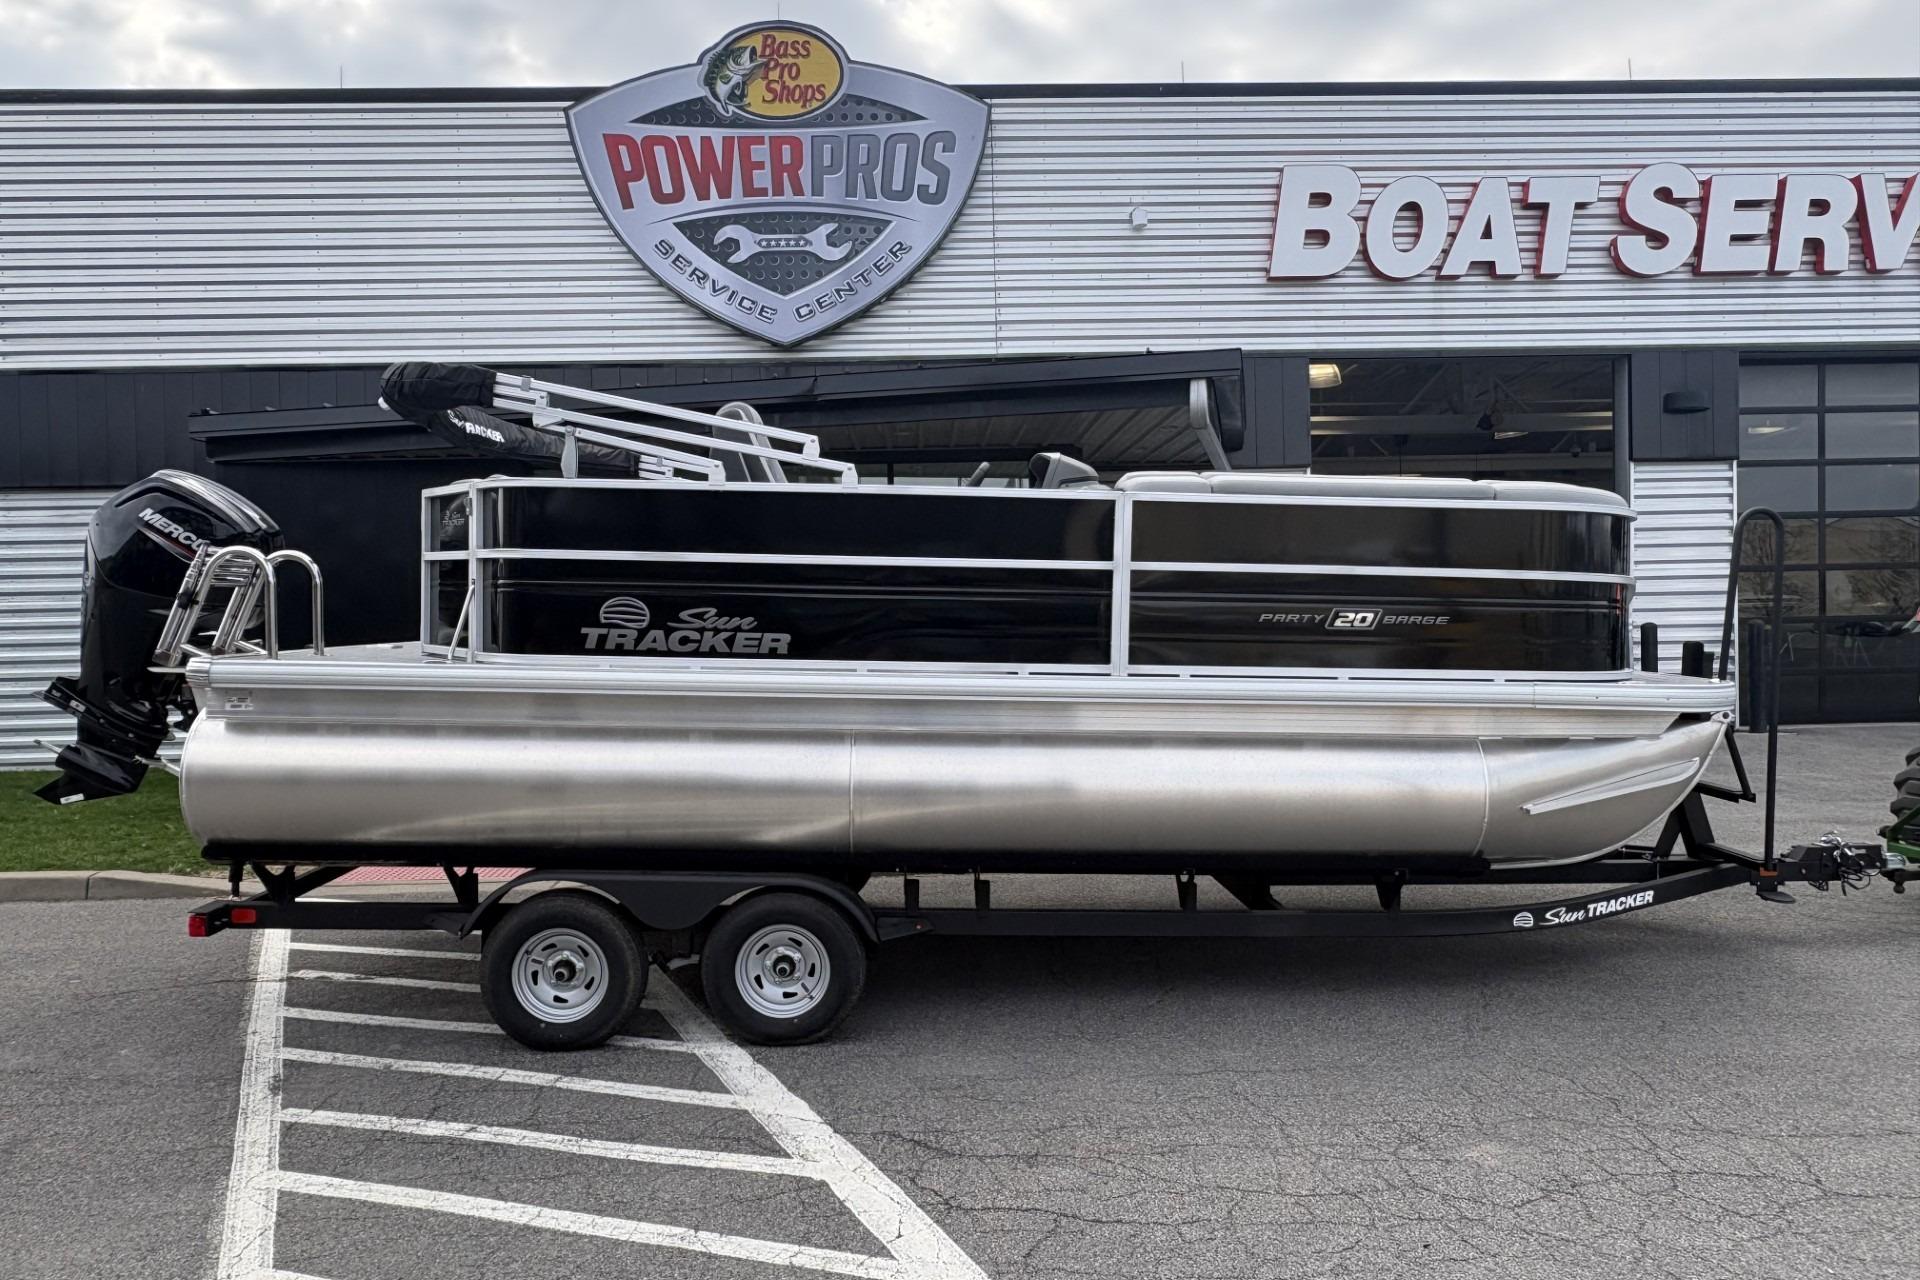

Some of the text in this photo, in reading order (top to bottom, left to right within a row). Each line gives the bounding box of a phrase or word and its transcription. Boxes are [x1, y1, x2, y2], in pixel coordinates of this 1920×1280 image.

[759, 33, 811, 59] Bass
[760, 57, 801, 81] Pro
[762, 79, 826, 109] Shops
[1267, 161, 1920, 281] BOAT SERV
[653, 238, 912, 325] SERVICE CENTER
[138, 507, 211, 551] MERCU
[666, 607, 758, 630] Sun
[1258, 612, 1451, 627] PARTY 20 BARGE
[580, 626, 792, 655] TRACKER
[1538, 890, 1655, 926] Sun TRACKER
